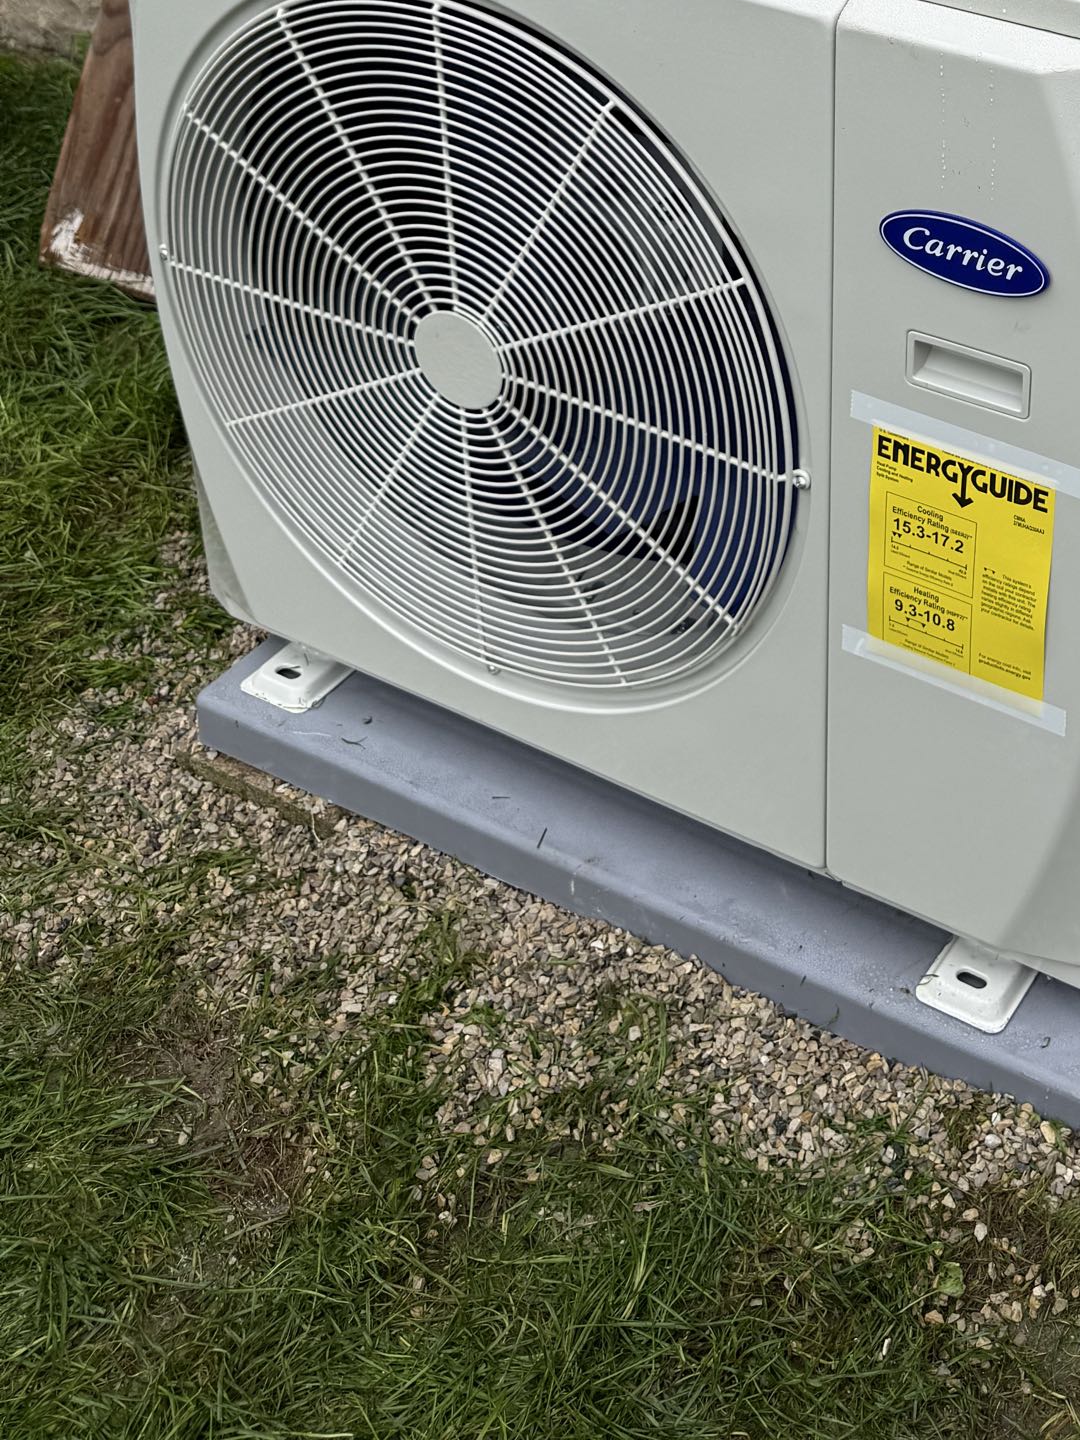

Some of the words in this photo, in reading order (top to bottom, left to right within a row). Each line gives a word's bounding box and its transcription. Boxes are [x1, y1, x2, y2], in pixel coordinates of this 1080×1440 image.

[902, 226, 1024, 281] Carrier
[878, 434, 1048, 514] ENERGYGUIDE
[892, 506, 926, 524] Efficiency
[927, 518, 949, 533] Rating
[917, 506, 944, 522] Cooling
[893, 518, 964, 554] 15.3-17.2
[890, 586, 921, 605] Efficiency
[923, 599, 945, 614] Rating
[914, 586, 939, 602] Heating
[895, 599, 955, 631] 9.3-10.8
